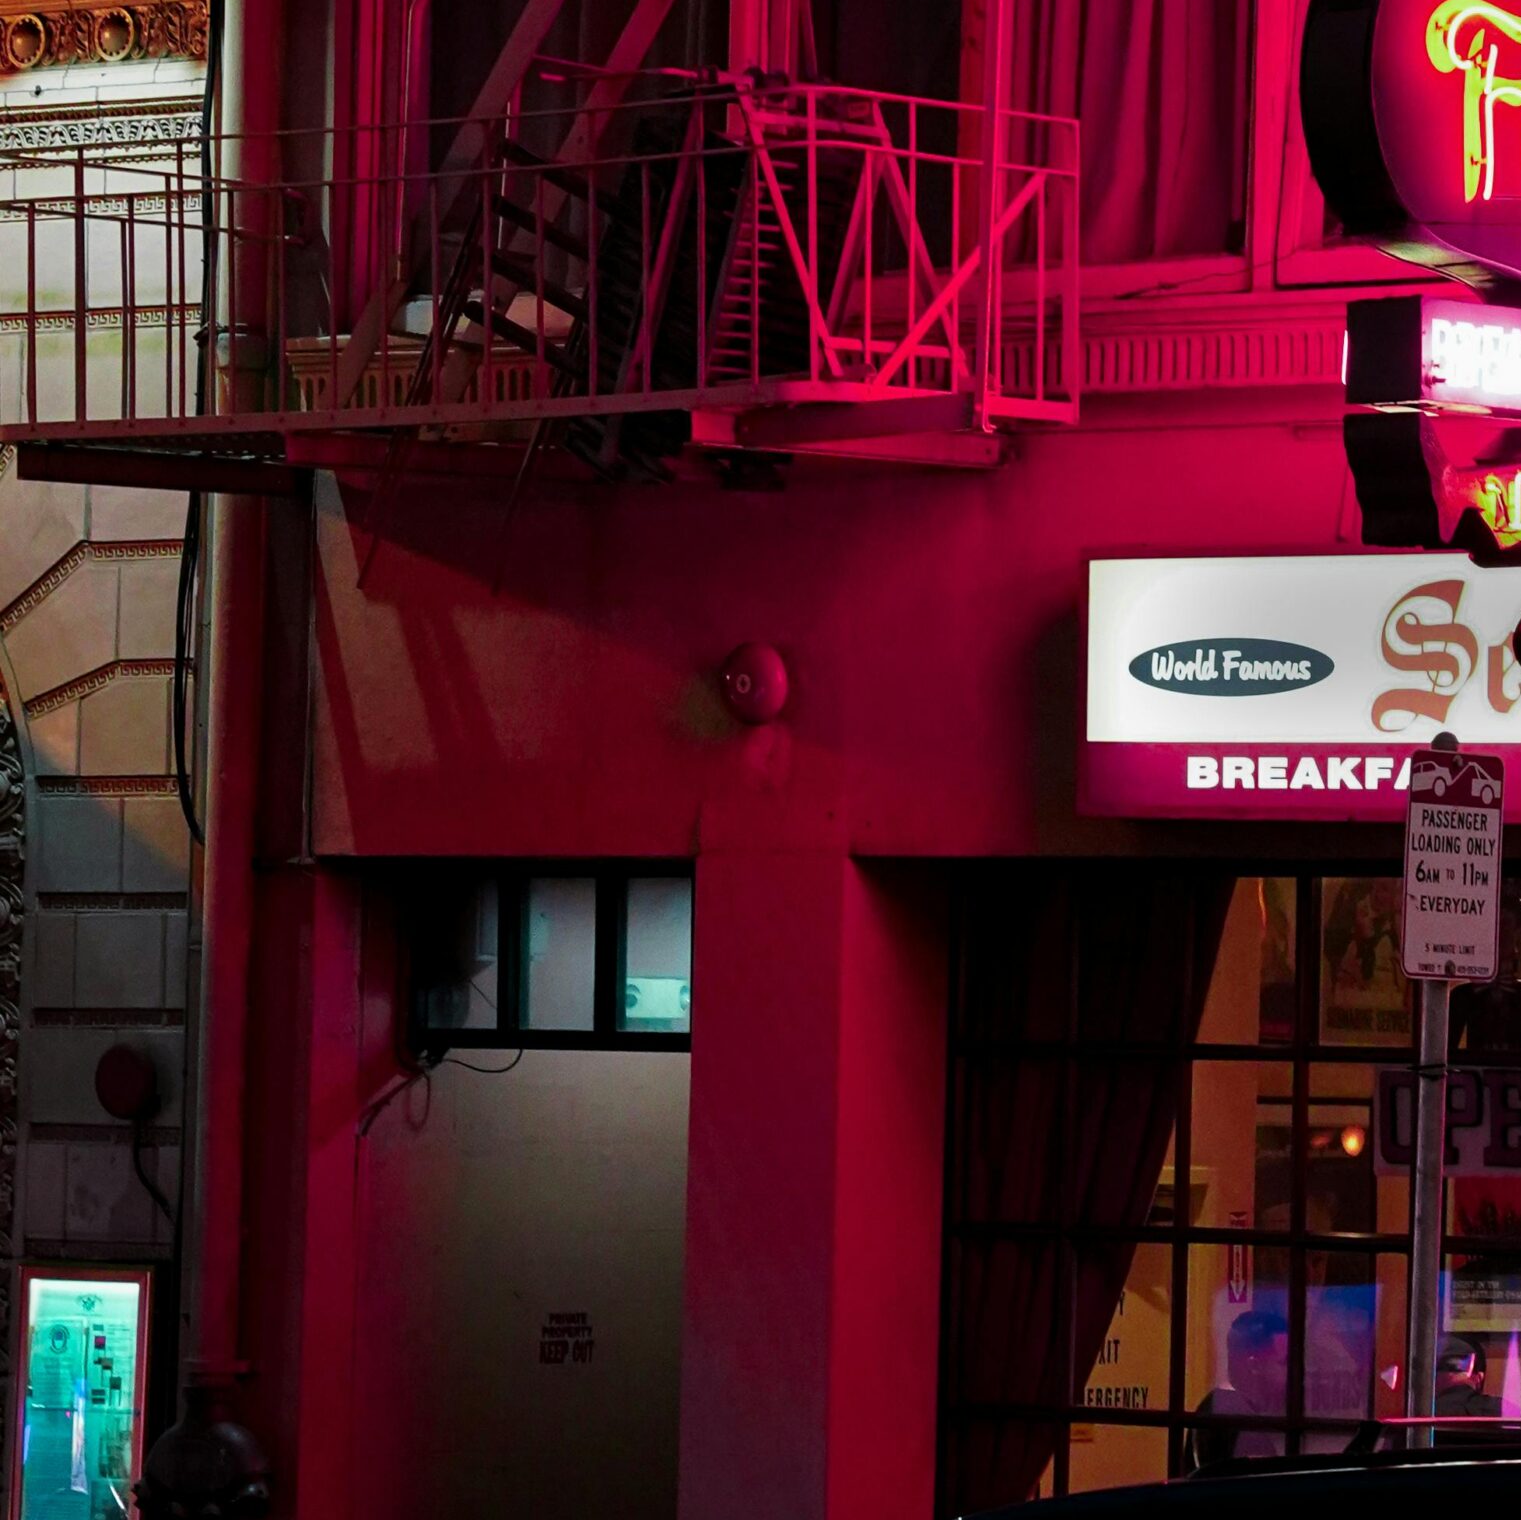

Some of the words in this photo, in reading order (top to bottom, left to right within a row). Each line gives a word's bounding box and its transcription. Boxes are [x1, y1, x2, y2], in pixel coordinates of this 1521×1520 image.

[1151, 648, 1220, 681] World
[1222, 649, 1312, 681] Famous
[1186, 755, 1412, 790] BREAKF
[1421, 808, 1488, 831] PASSENGER
[1411, 832, 1461, 855] LOADING
[1466, 836, 1496, 857] ONLY
[1415, 859, 1440, 883] 6AM
[1446, 868, 1456, 881] TO
[1462, 862, 1489, 886] 11PM
[1420, 894, 1486, 916] EVERYDAY
[1432, 943, 1457, 955] MINUTE
[1458, 944, 1476, 956] LIMIT
[548, 1312, 588, 1325] PRIVATE
[540, 1340, 569, 1364] KEEP
[573, 1339, 594, 1363] OUT
[1098, 1339, 1120, 1365] XIT
[1087, 1386, 1149, 1409] ERGENCY
